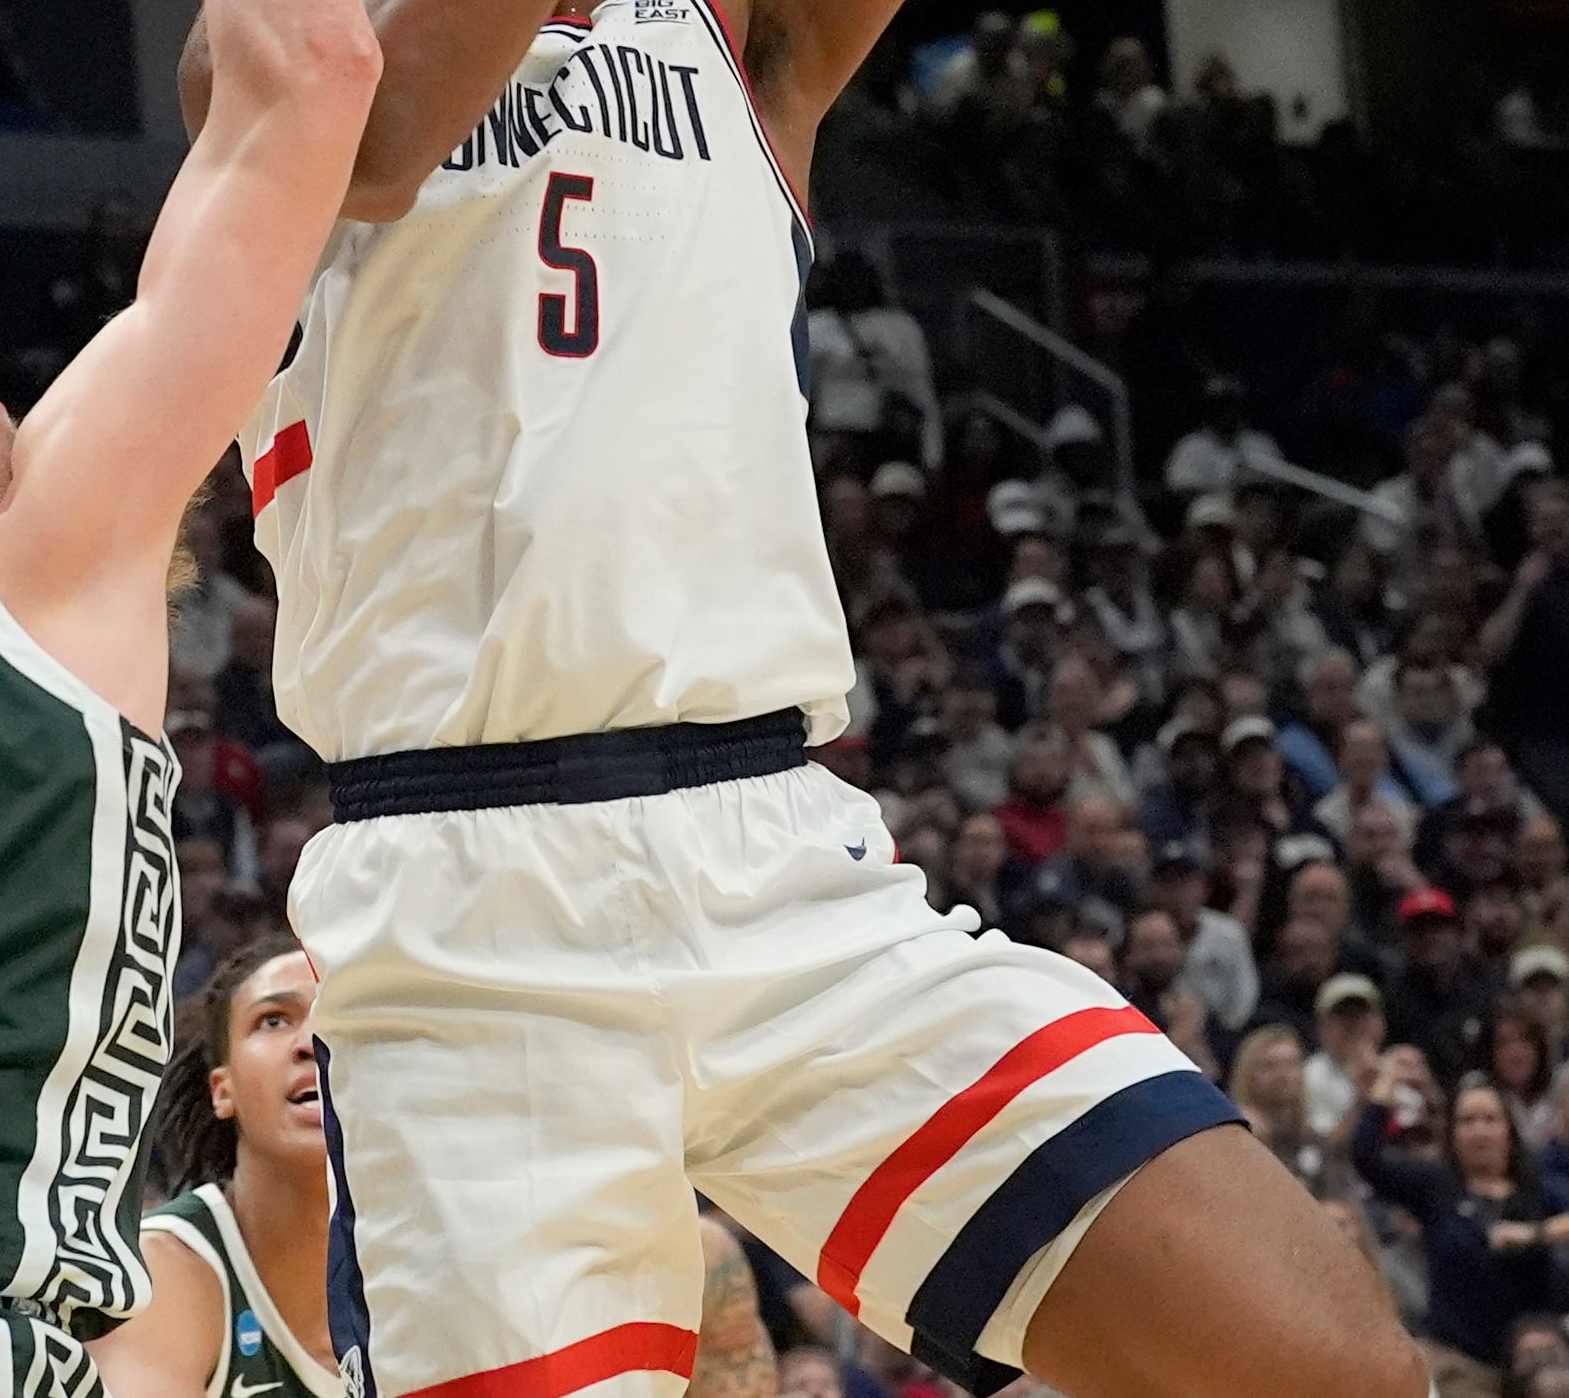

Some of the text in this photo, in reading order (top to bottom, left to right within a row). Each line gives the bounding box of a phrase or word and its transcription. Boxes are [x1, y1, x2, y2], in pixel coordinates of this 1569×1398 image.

[634, 9, 690, 20] EAST
[440, 43, 712, 171] NNECTICUT
[538, 171, 599, 358] 5
